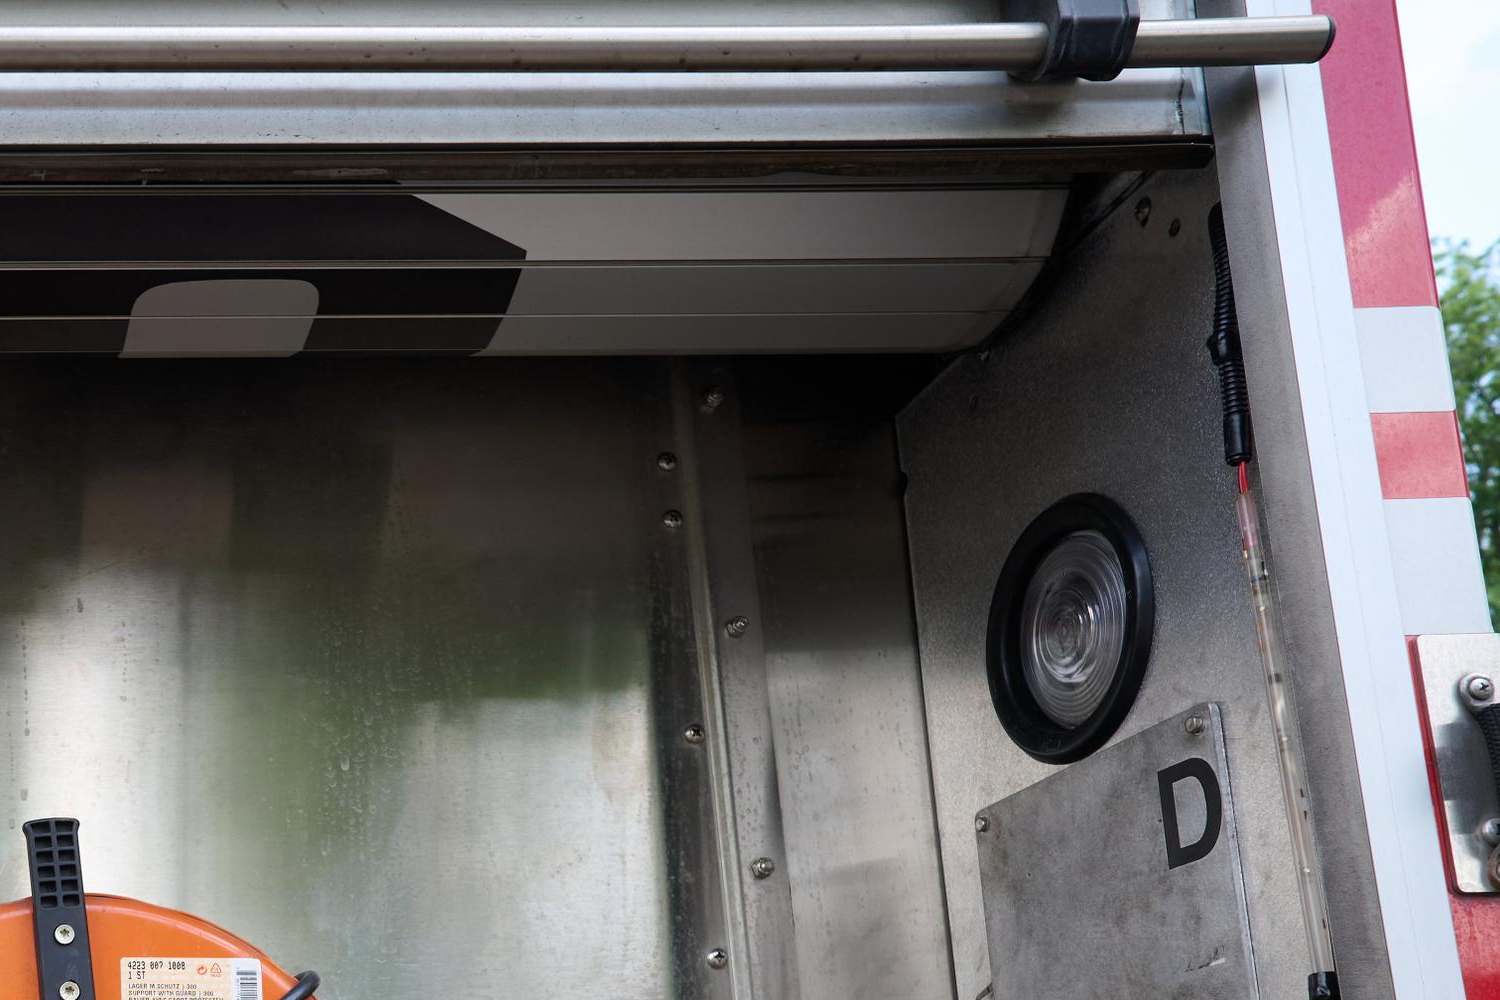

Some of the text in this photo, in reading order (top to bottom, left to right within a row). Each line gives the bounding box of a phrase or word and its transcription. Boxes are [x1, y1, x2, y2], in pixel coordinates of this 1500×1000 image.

[1157, 757, 1222, 869] D
[127, 961, 145, 970] 4223
[128, 971, 145, 979] 1 ST
